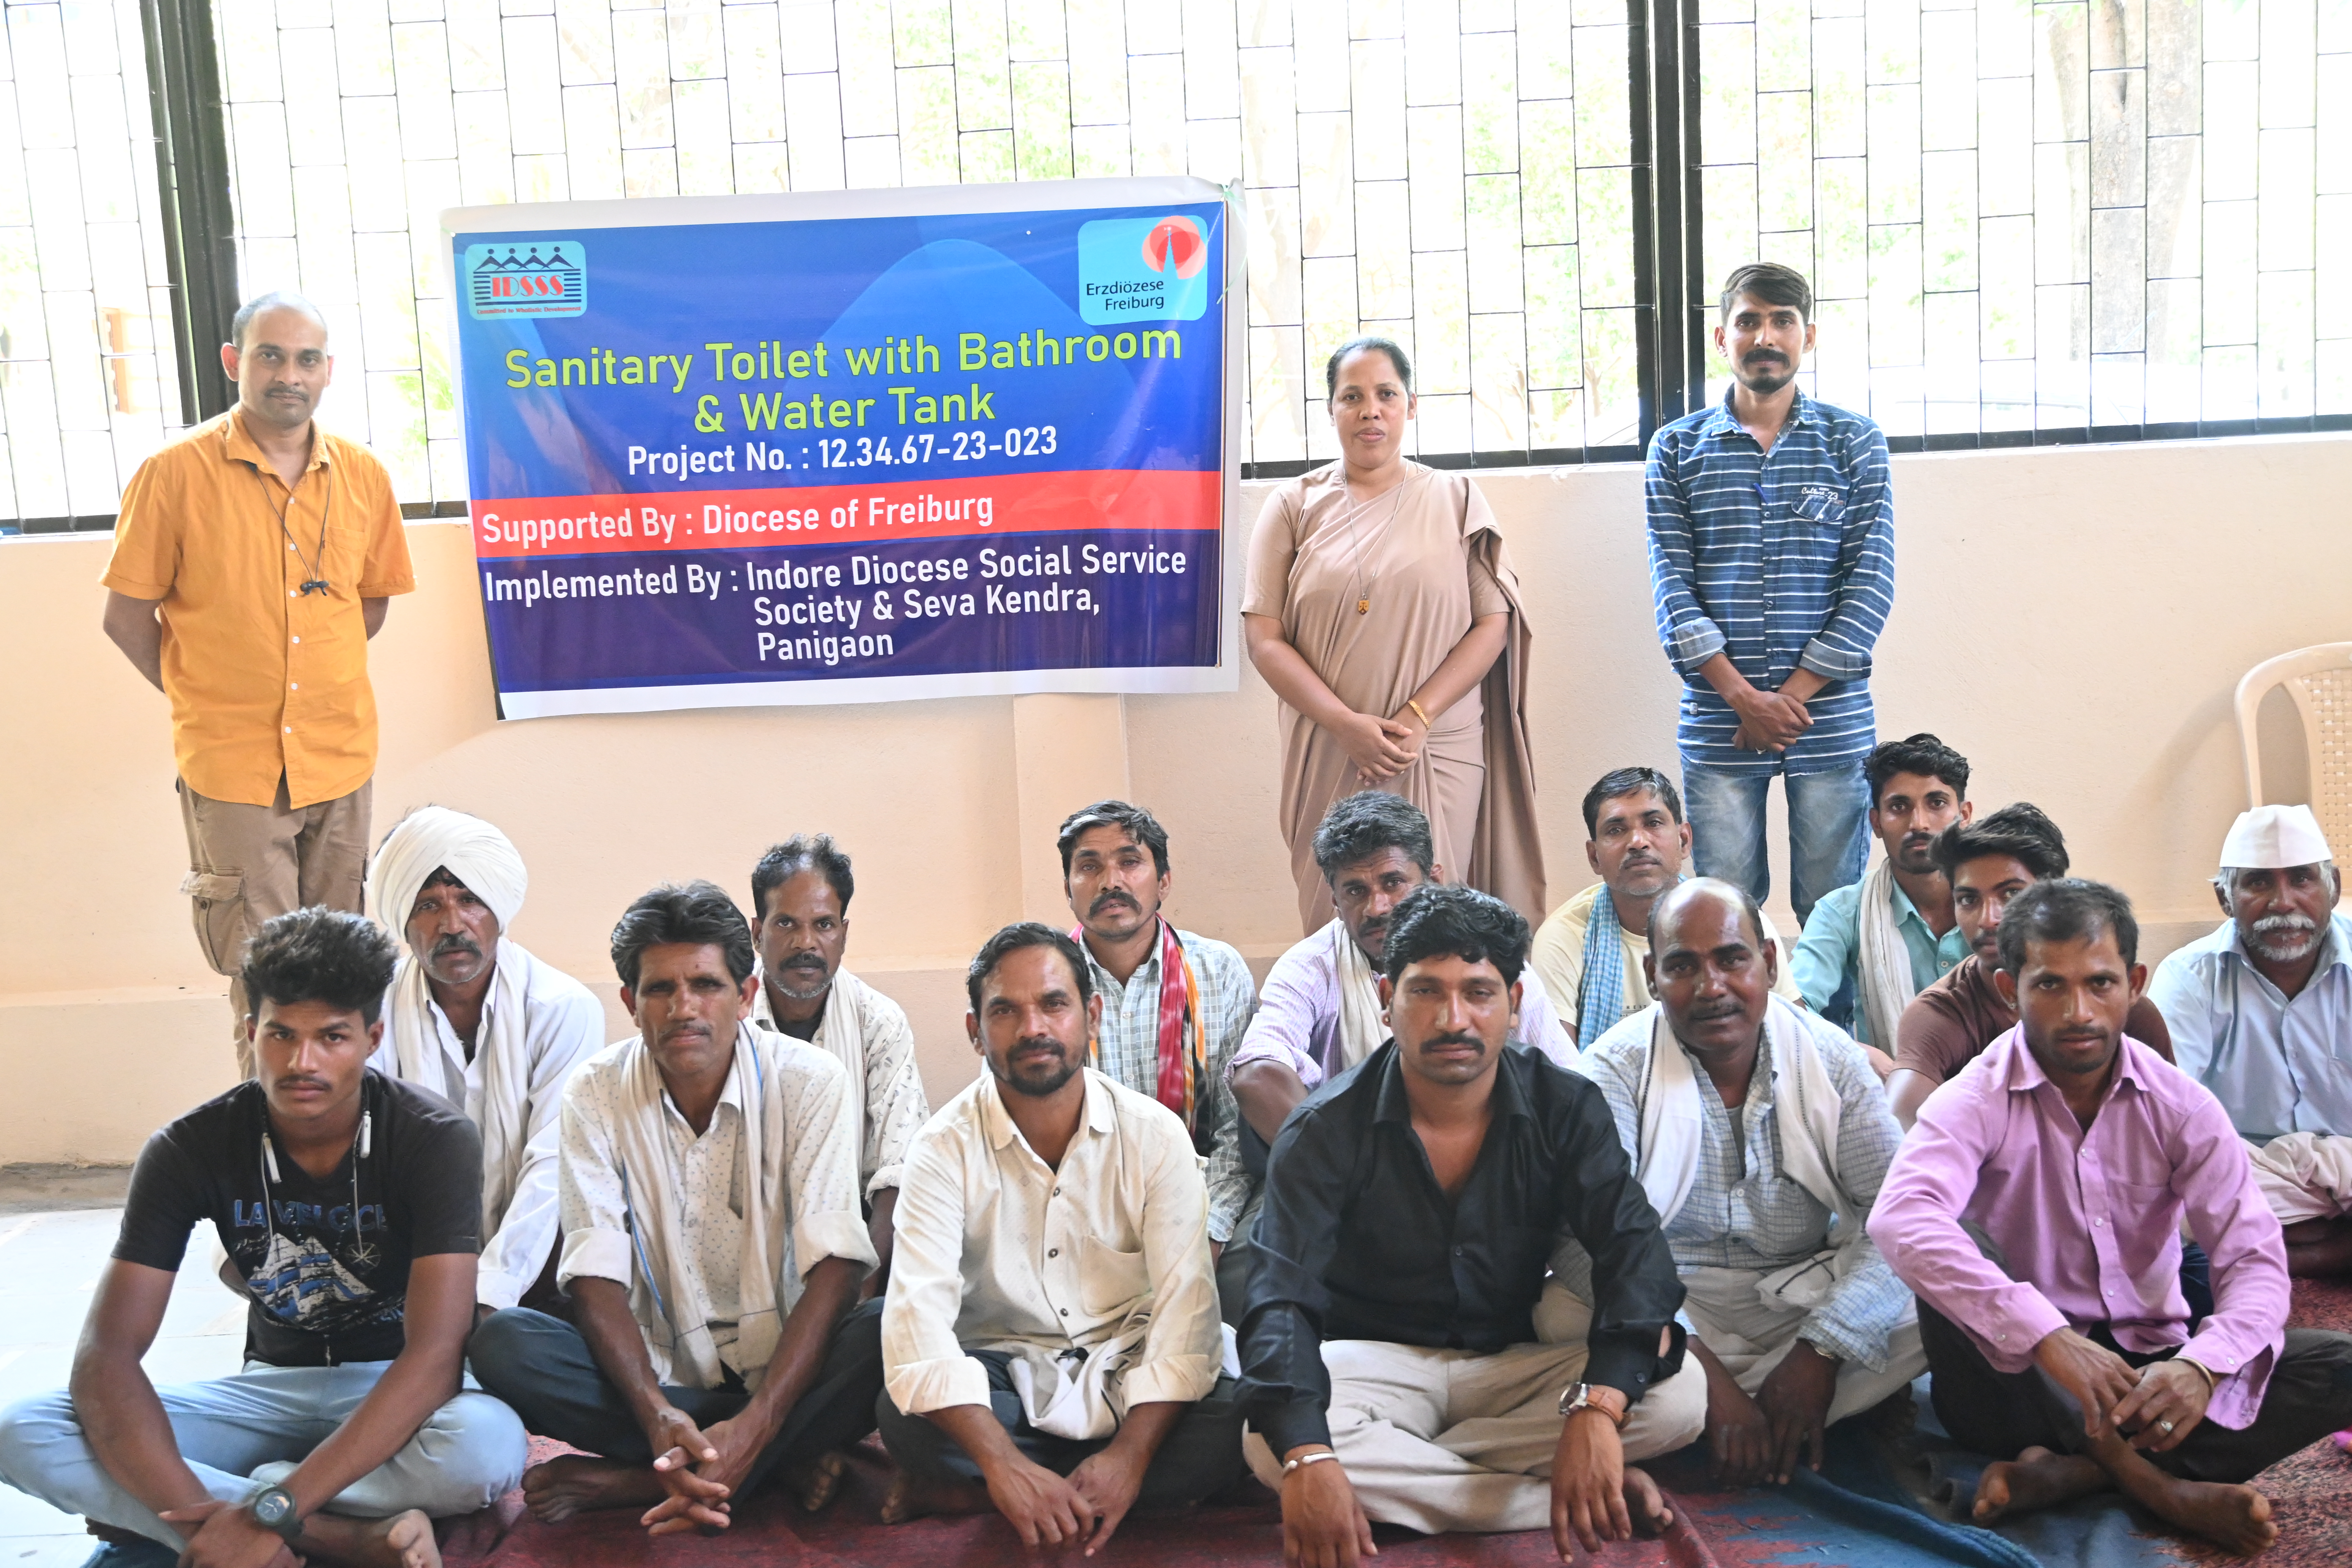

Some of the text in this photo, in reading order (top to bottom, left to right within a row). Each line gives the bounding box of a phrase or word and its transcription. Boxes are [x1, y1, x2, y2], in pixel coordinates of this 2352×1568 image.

[493, 275, 564, 297] IDSSS
[1086, 280, 1164, 296] Erzdiözese
[1105, 296, 1164, 310] Freiburg
[506, 329, 1181, 393] Sanitary Toilet with Bathroom
[695, 384, 995, 433] & Water Tank
[629, 426, 1056, 481] Project No. : 12.34.67-23-023
[482, 494, 993, 549] Supported By : Diocese of Freiburg
[486, 544, 1186, 607] Implemented By : Indore Diocese Social Service
[754, 582, 1099, 629] Society & Seva Kendra,
[758, 630, 893, 665] Panigaon
